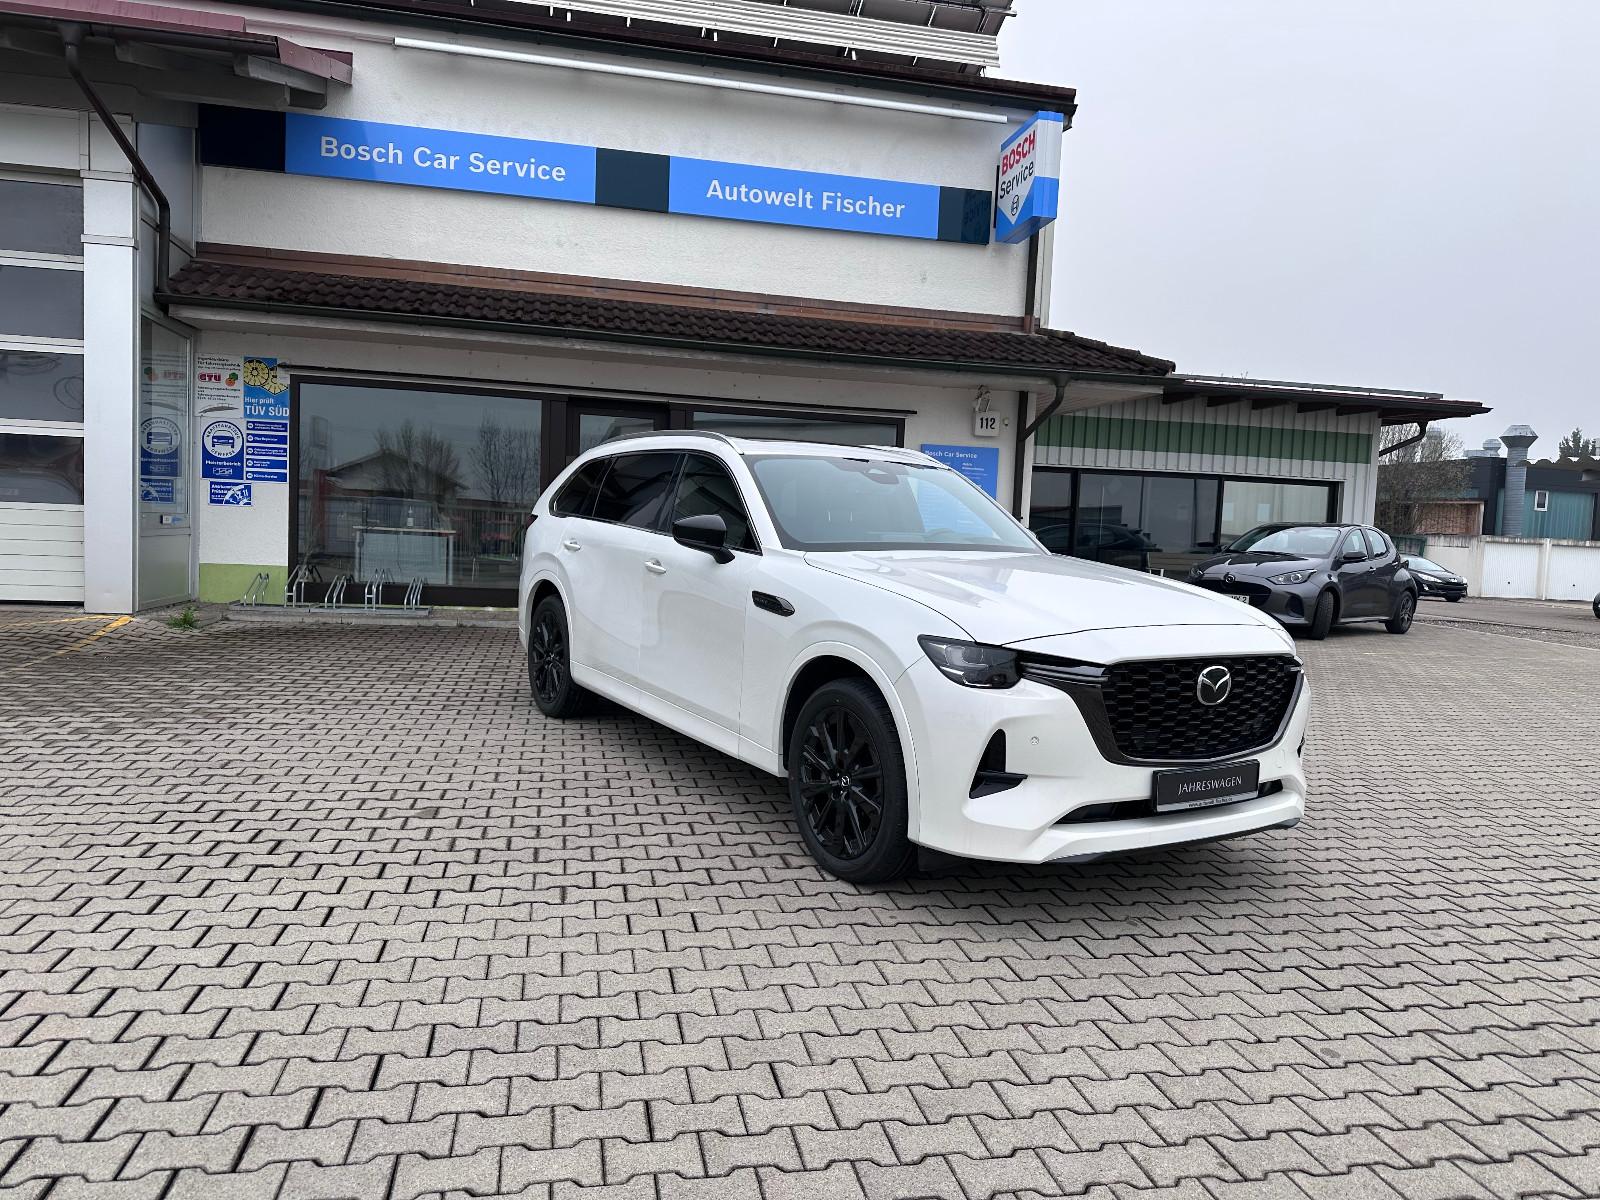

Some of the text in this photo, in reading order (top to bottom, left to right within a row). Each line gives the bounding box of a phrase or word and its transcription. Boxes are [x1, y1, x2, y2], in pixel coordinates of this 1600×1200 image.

[320, 135, 566, 182] Bosch Car Service
[1001, 129, 1036, 176] BOSCH
[1000, 161, 1034, 199] Service
[706, 179, 906, 218] Autowelt Fischer
[245, 403, 289, 417] TÜV SÜD
[980, 417, 996, 430] 112
[205, 459, 241, 467] Meisterbetrieb
[1178, 775, 1243, 796] JAHRESWAGEN
